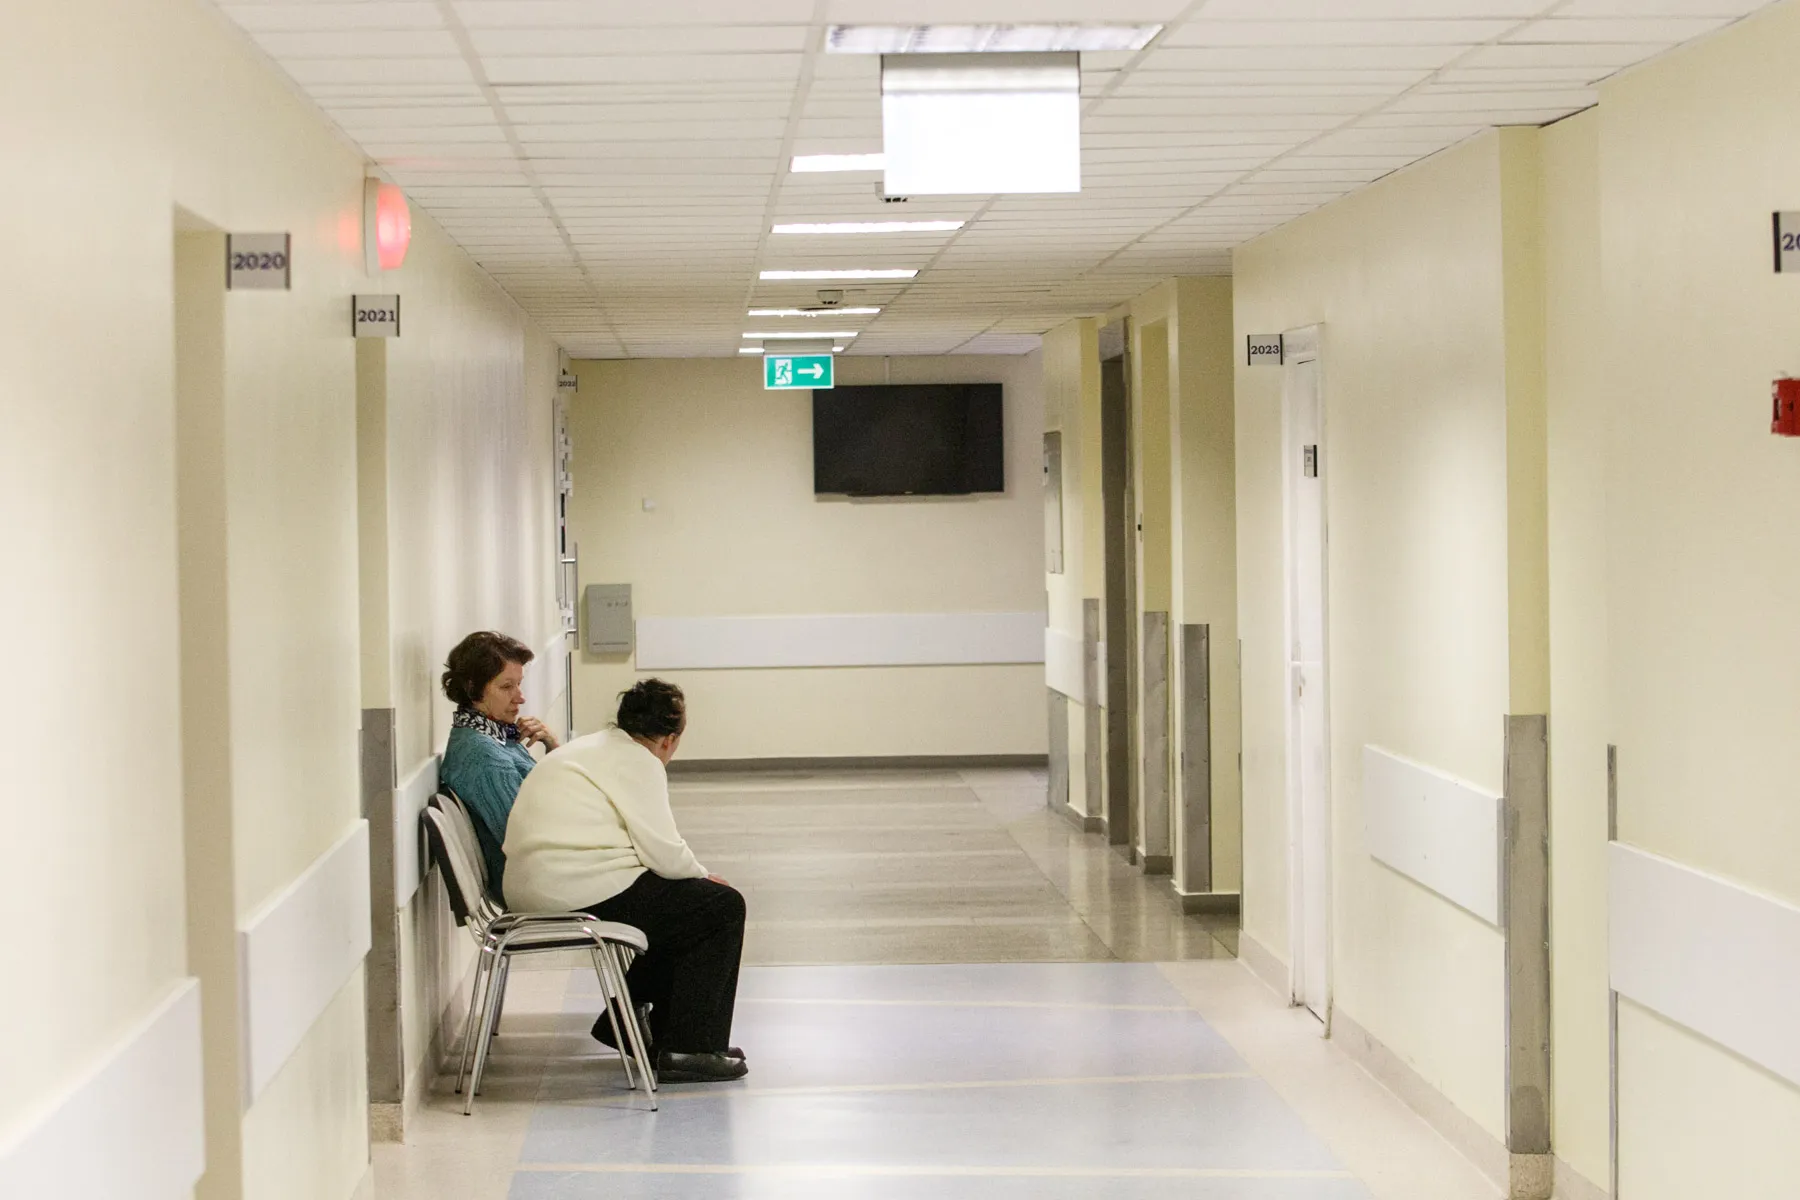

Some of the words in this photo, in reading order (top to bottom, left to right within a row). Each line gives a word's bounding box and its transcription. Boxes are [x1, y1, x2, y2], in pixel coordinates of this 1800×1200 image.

[233, 252, 286, 270] 2020
[358, 310, 395, 322] 2021
[1250, 345, 1280, 355] 2023
